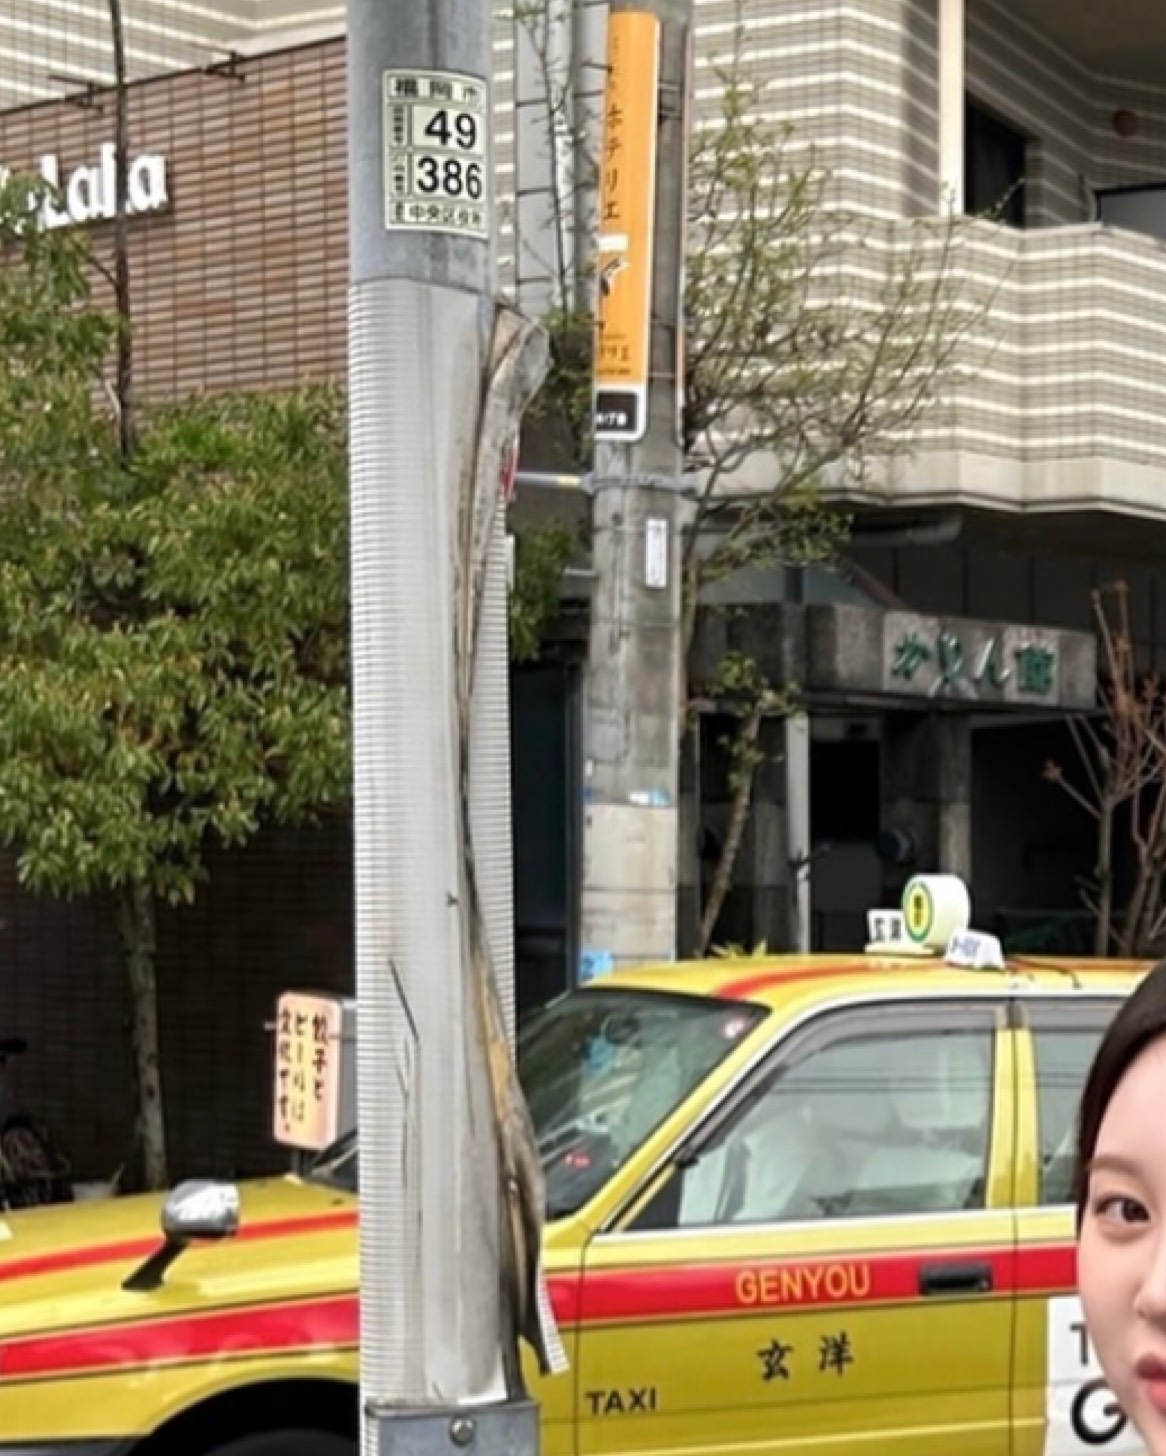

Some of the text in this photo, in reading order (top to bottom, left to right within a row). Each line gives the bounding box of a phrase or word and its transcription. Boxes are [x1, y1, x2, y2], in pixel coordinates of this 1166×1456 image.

[424, 110, 477, 150] 49
[416, 155, 483, 200] 386
[735, 1262, 870, 1304] GENYOU
[756, 1330, 855, 1381] 玄洋
[585, 1386, 657, 1415] TAXI
